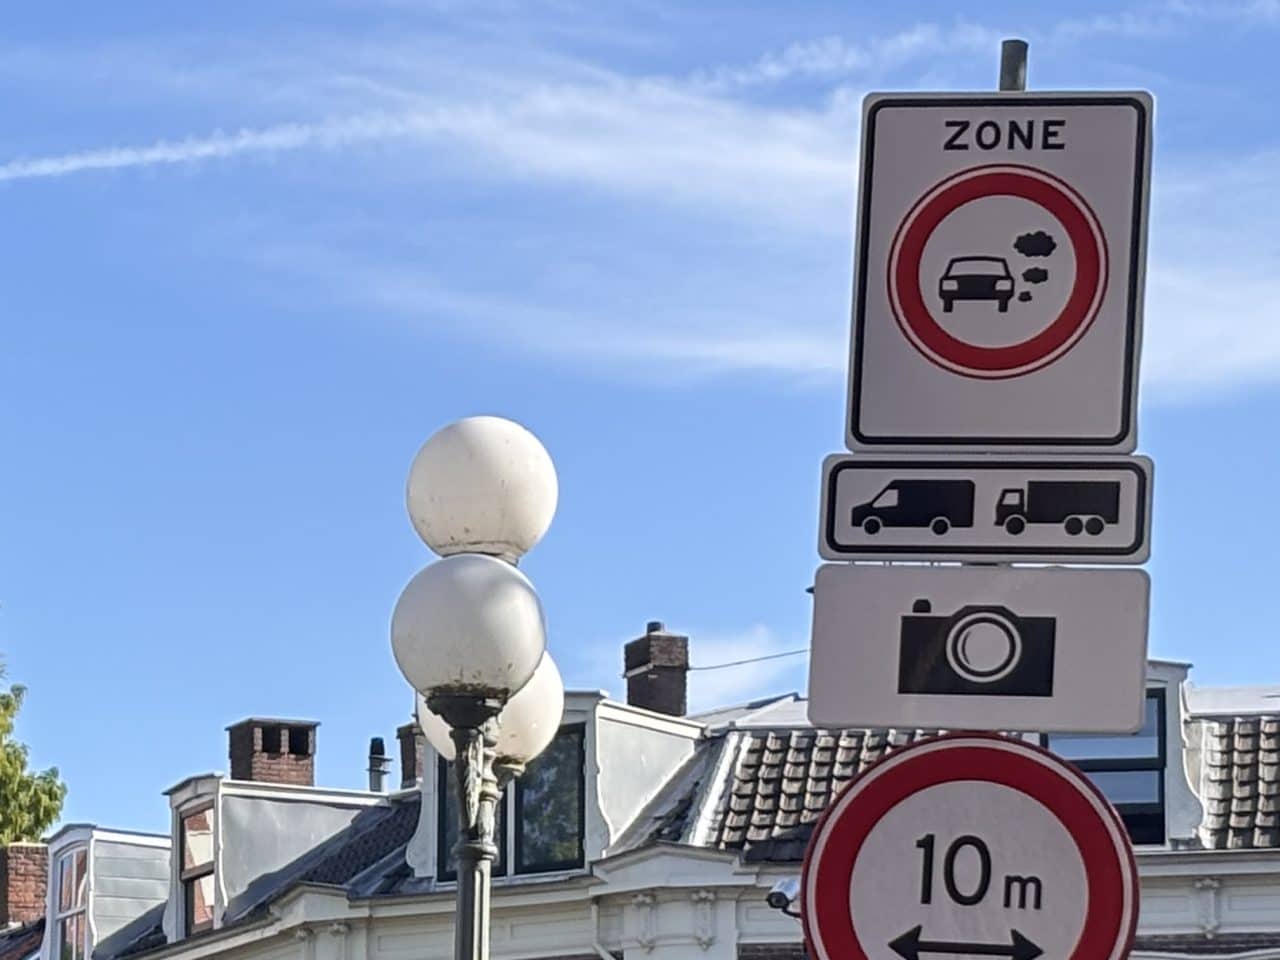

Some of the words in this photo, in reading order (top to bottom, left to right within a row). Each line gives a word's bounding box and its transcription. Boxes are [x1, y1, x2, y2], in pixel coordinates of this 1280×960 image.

[943, 119, 1066, 151] ZONE
[915, 833, 992, 907] 10
[1003, 875, 1043, 910] m
